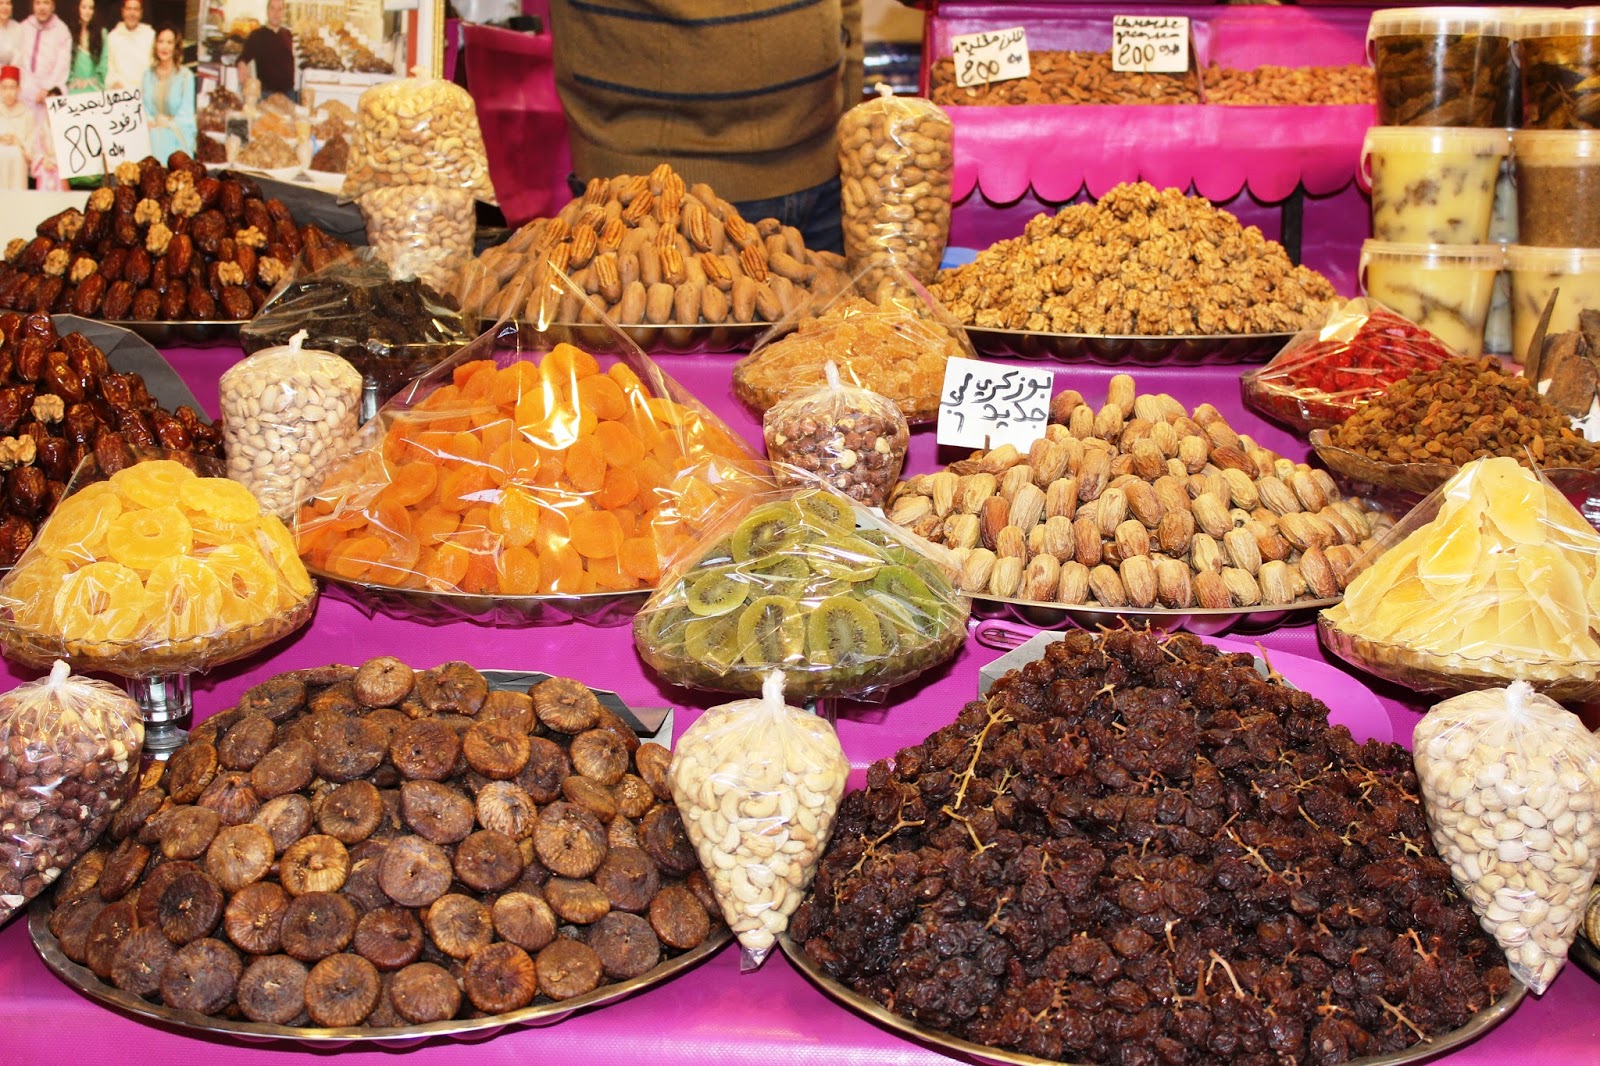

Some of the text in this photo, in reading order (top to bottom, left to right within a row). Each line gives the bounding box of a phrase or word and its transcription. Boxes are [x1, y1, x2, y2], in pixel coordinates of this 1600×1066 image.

[1118, 43, 1155, 66] 200
[961, 60, 1000, 84] 200
[64, 124, 102, 174] 80
